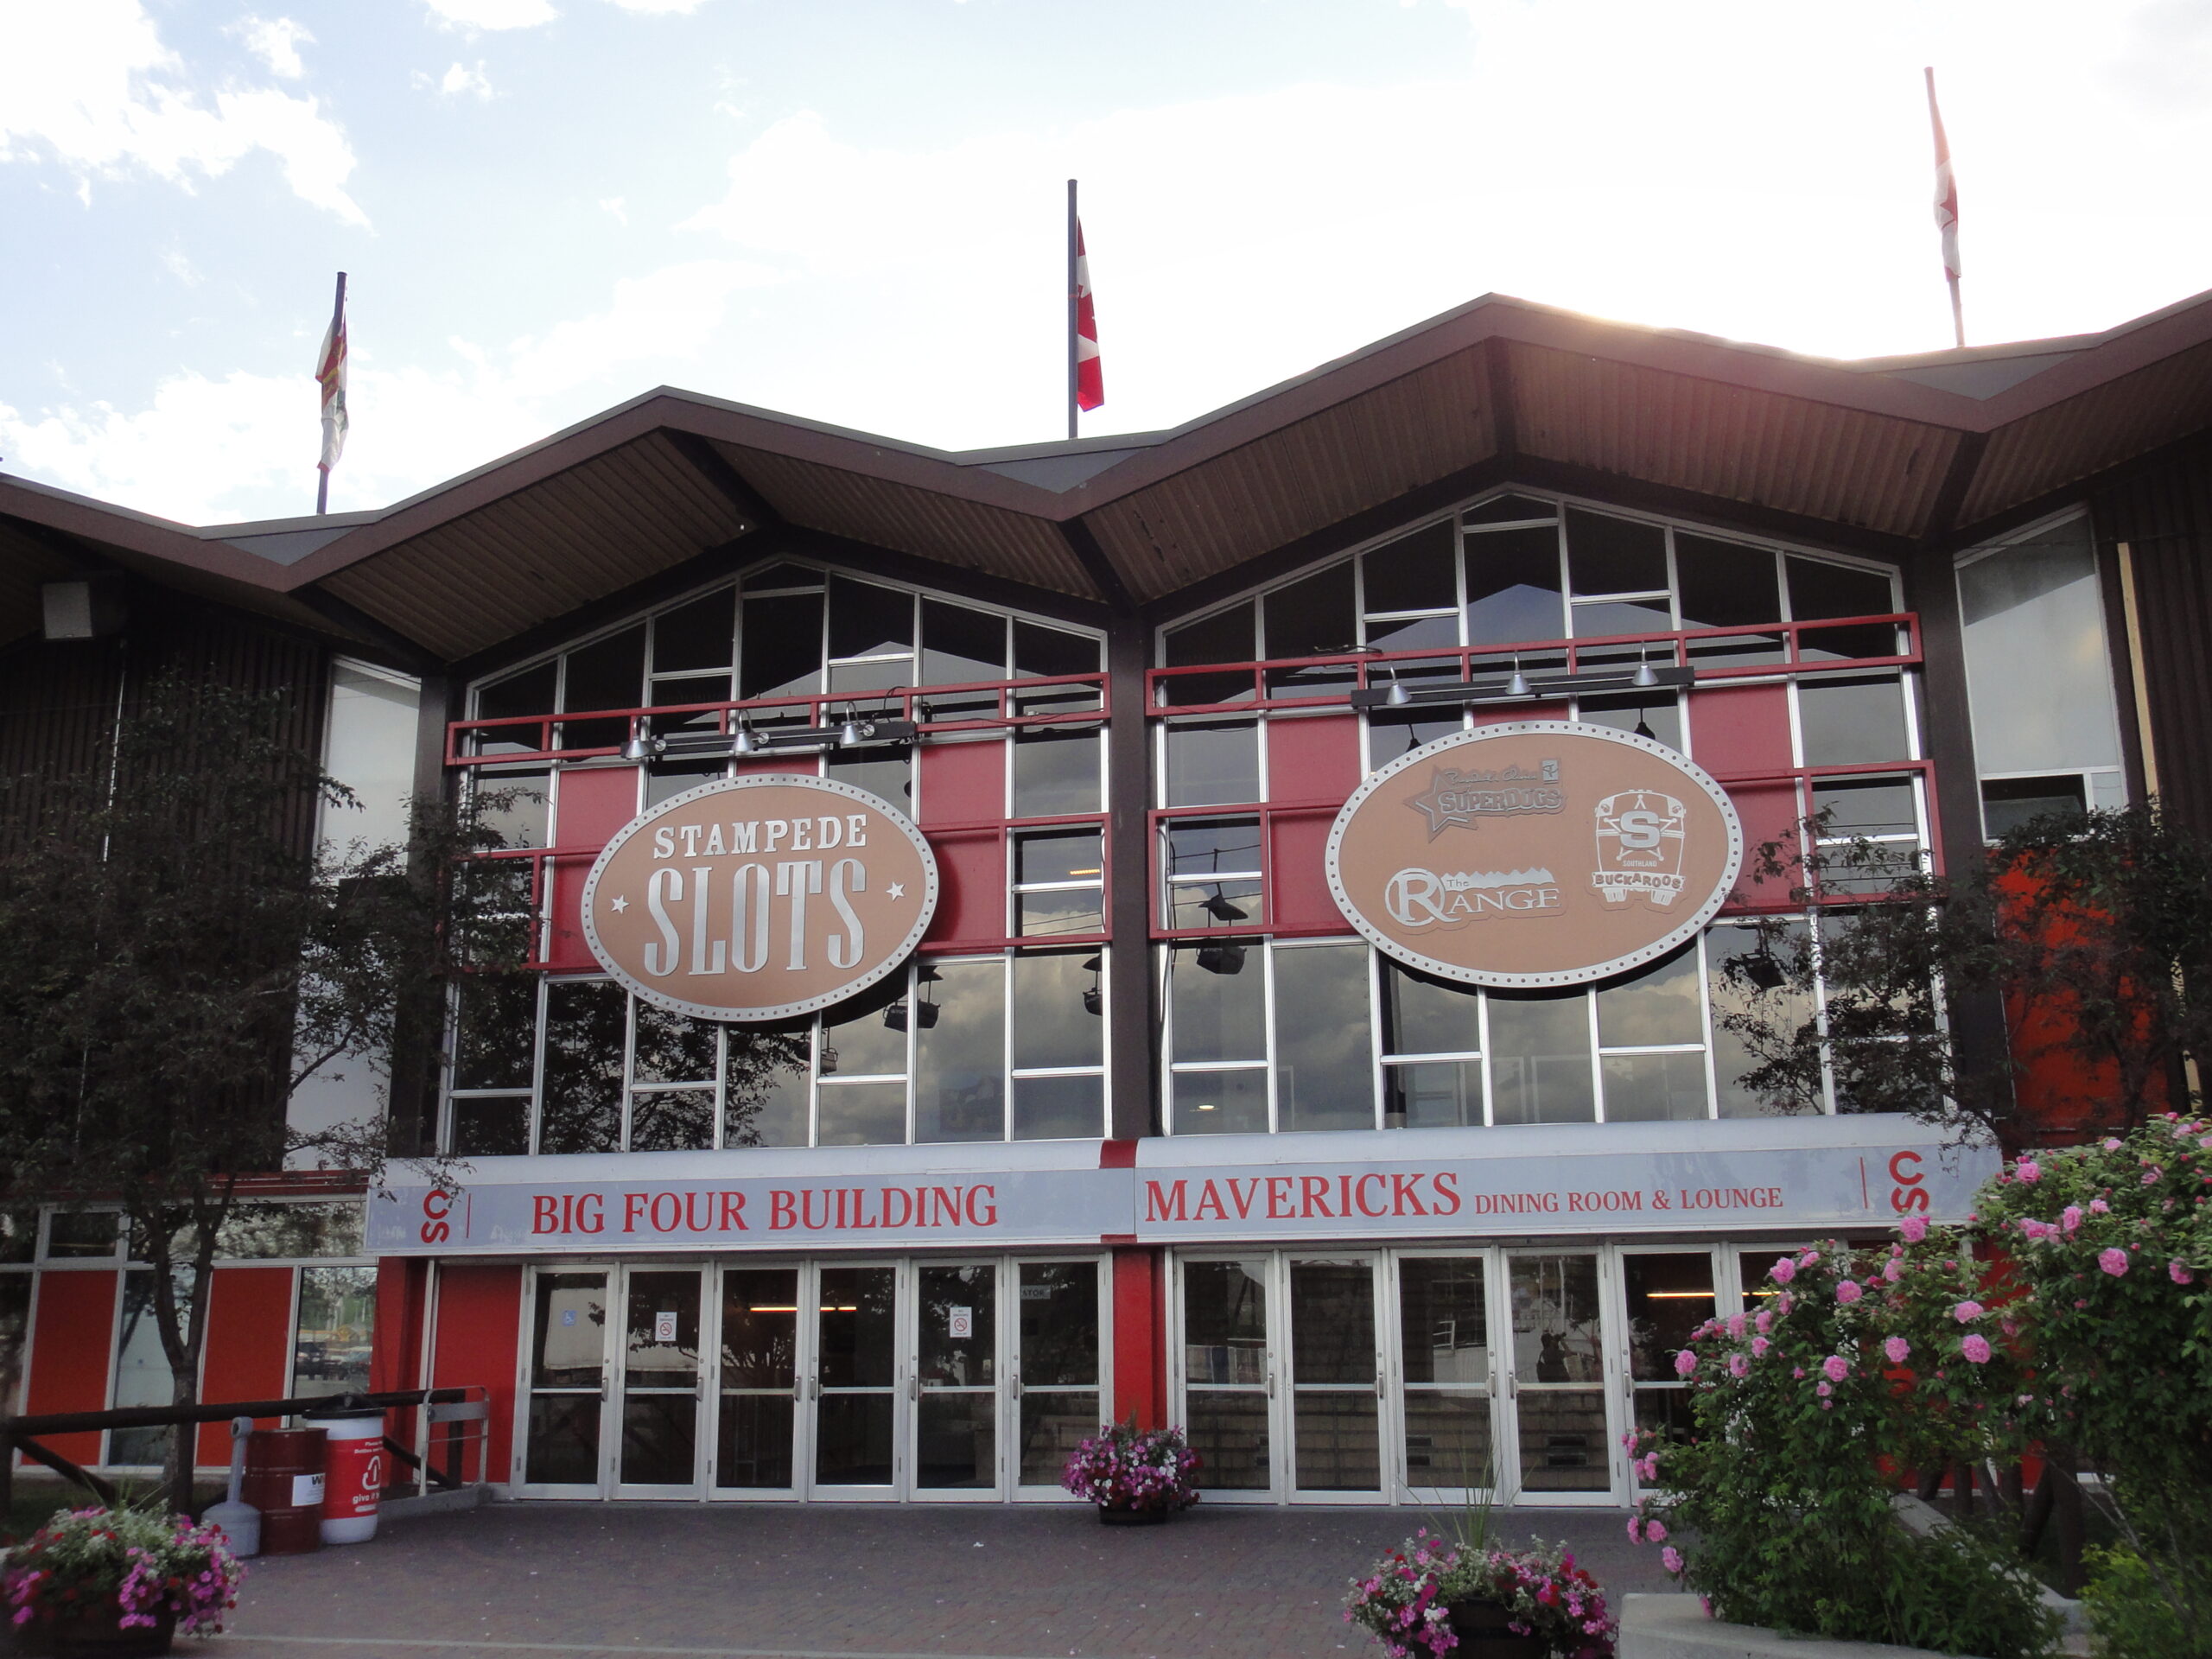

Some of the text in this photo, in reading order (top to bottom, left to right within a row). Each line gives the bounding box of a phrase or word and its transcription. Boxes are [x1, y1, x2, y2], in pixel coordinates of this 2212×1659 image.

[1438, 787, 1562, 814] SUPERDOGS
[653, 814, 867, 859] STAMPEDE
[1620, 810, 1661, 849] S
[1389, 873, 1561, 924] RANGE
[1446, 879, 1469, 888] The
[1595, 873, 1681, 889] BUCKAROOS
[644, 858, 866, 977] SLOTS
[531, 1184, 998, 1235] BIG FOUR BUILDING
[1145, 1172, 1783, 1222] MAVERICKS DINING ROOM & LOUNGE
